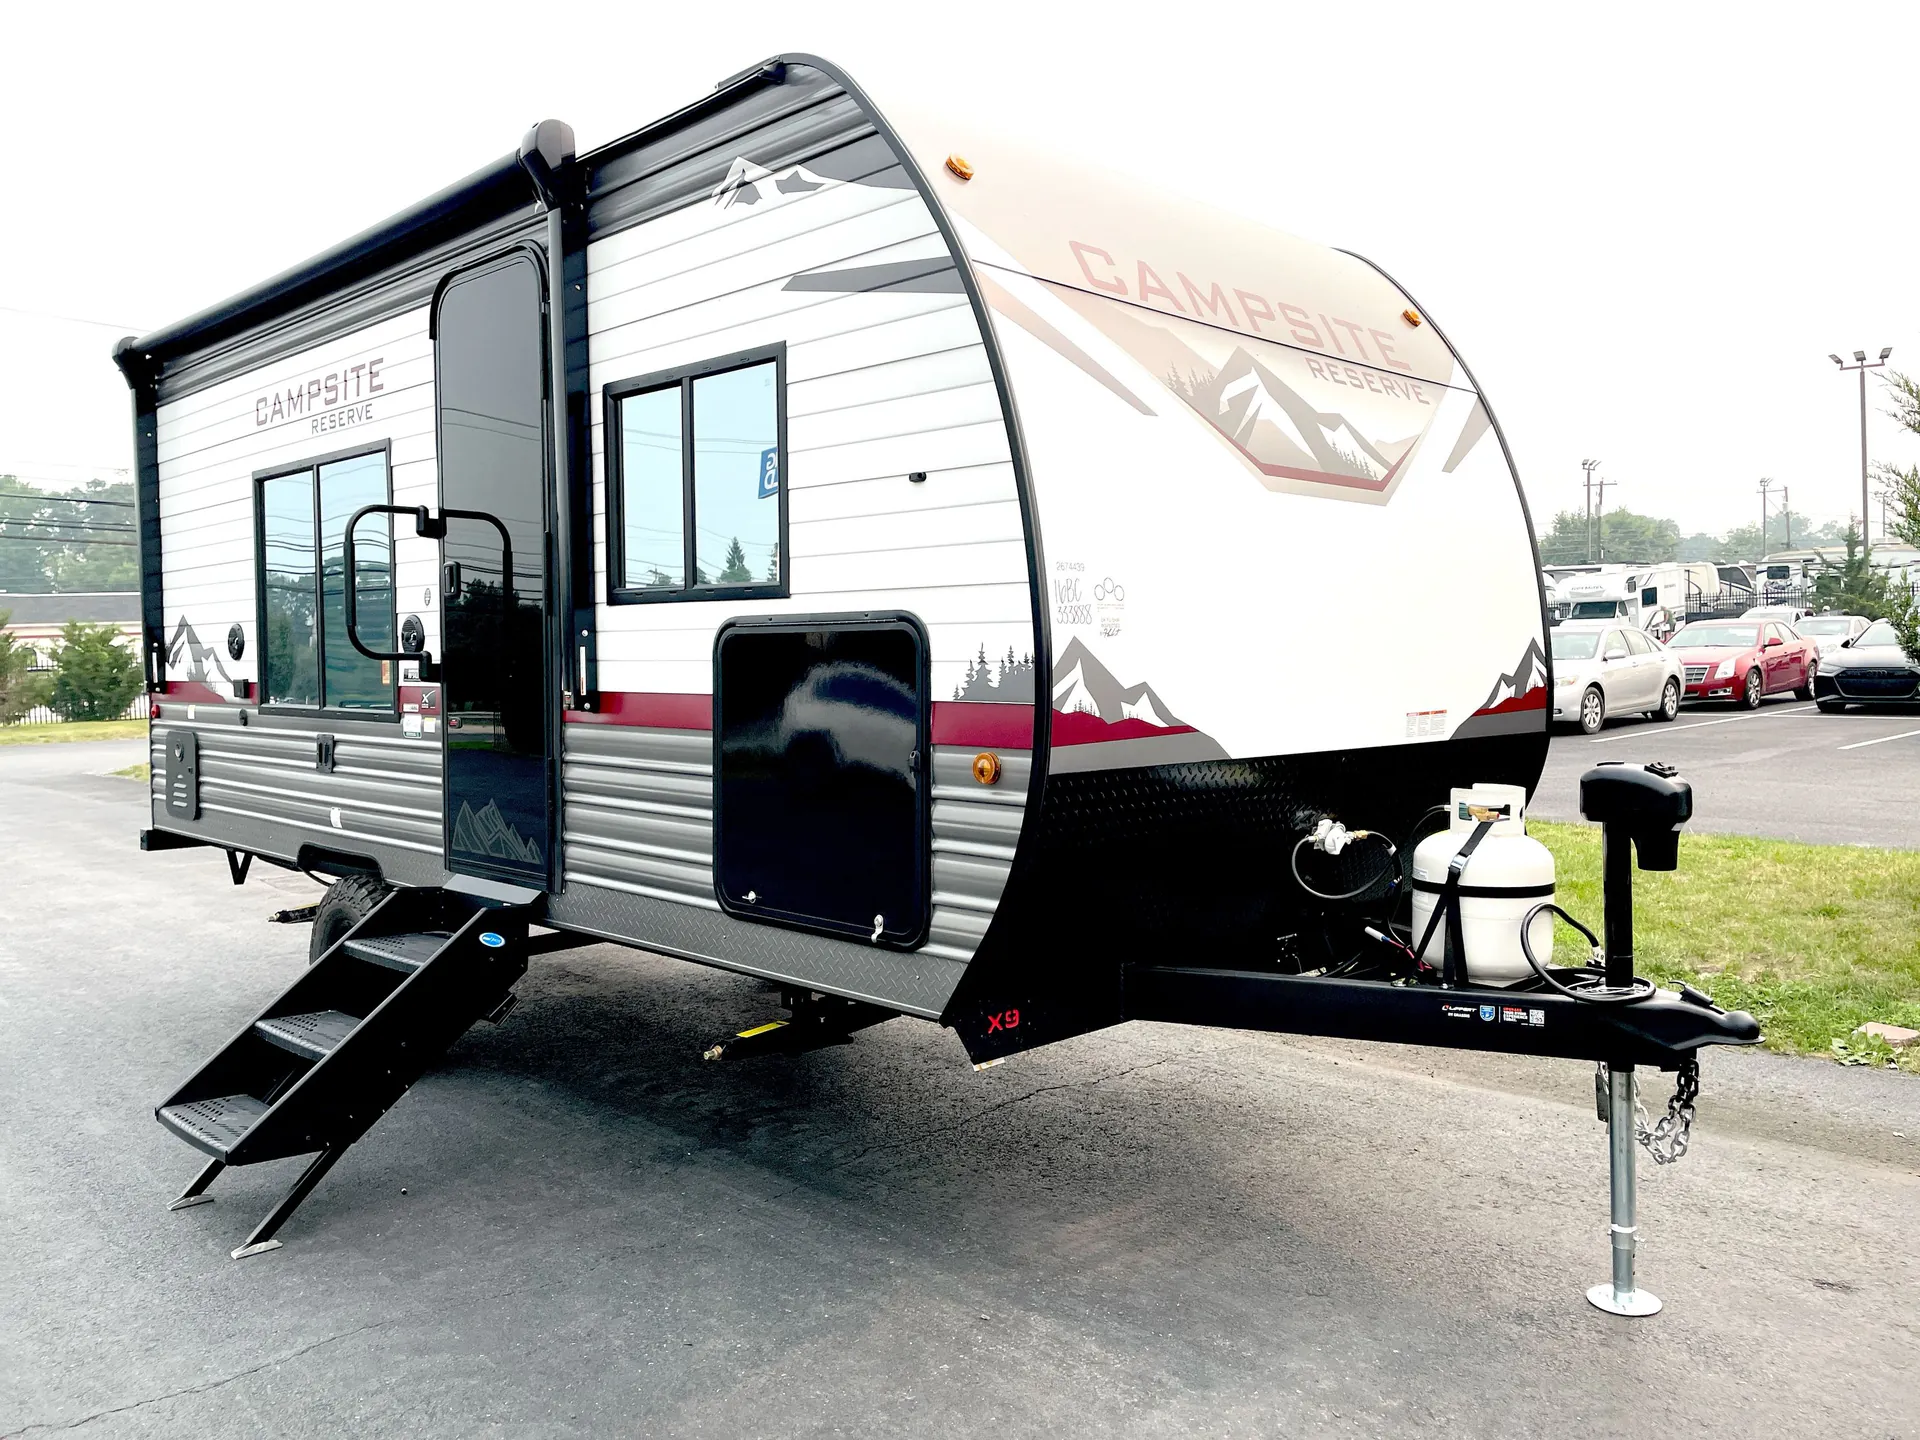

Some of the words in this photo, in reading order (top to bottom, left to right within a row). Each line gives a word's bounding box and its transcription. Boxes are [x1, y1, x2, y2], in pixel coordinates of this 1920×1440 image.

[1068, 240, 1412, 371] CAMPSITE
[256, 357, 384, 426] CAMPSITE
[1304, 357, 1430, 405] RESERVE
[311, 403, 373, 434] RESERVE
[988, 1009, 1019, 1034] X9
